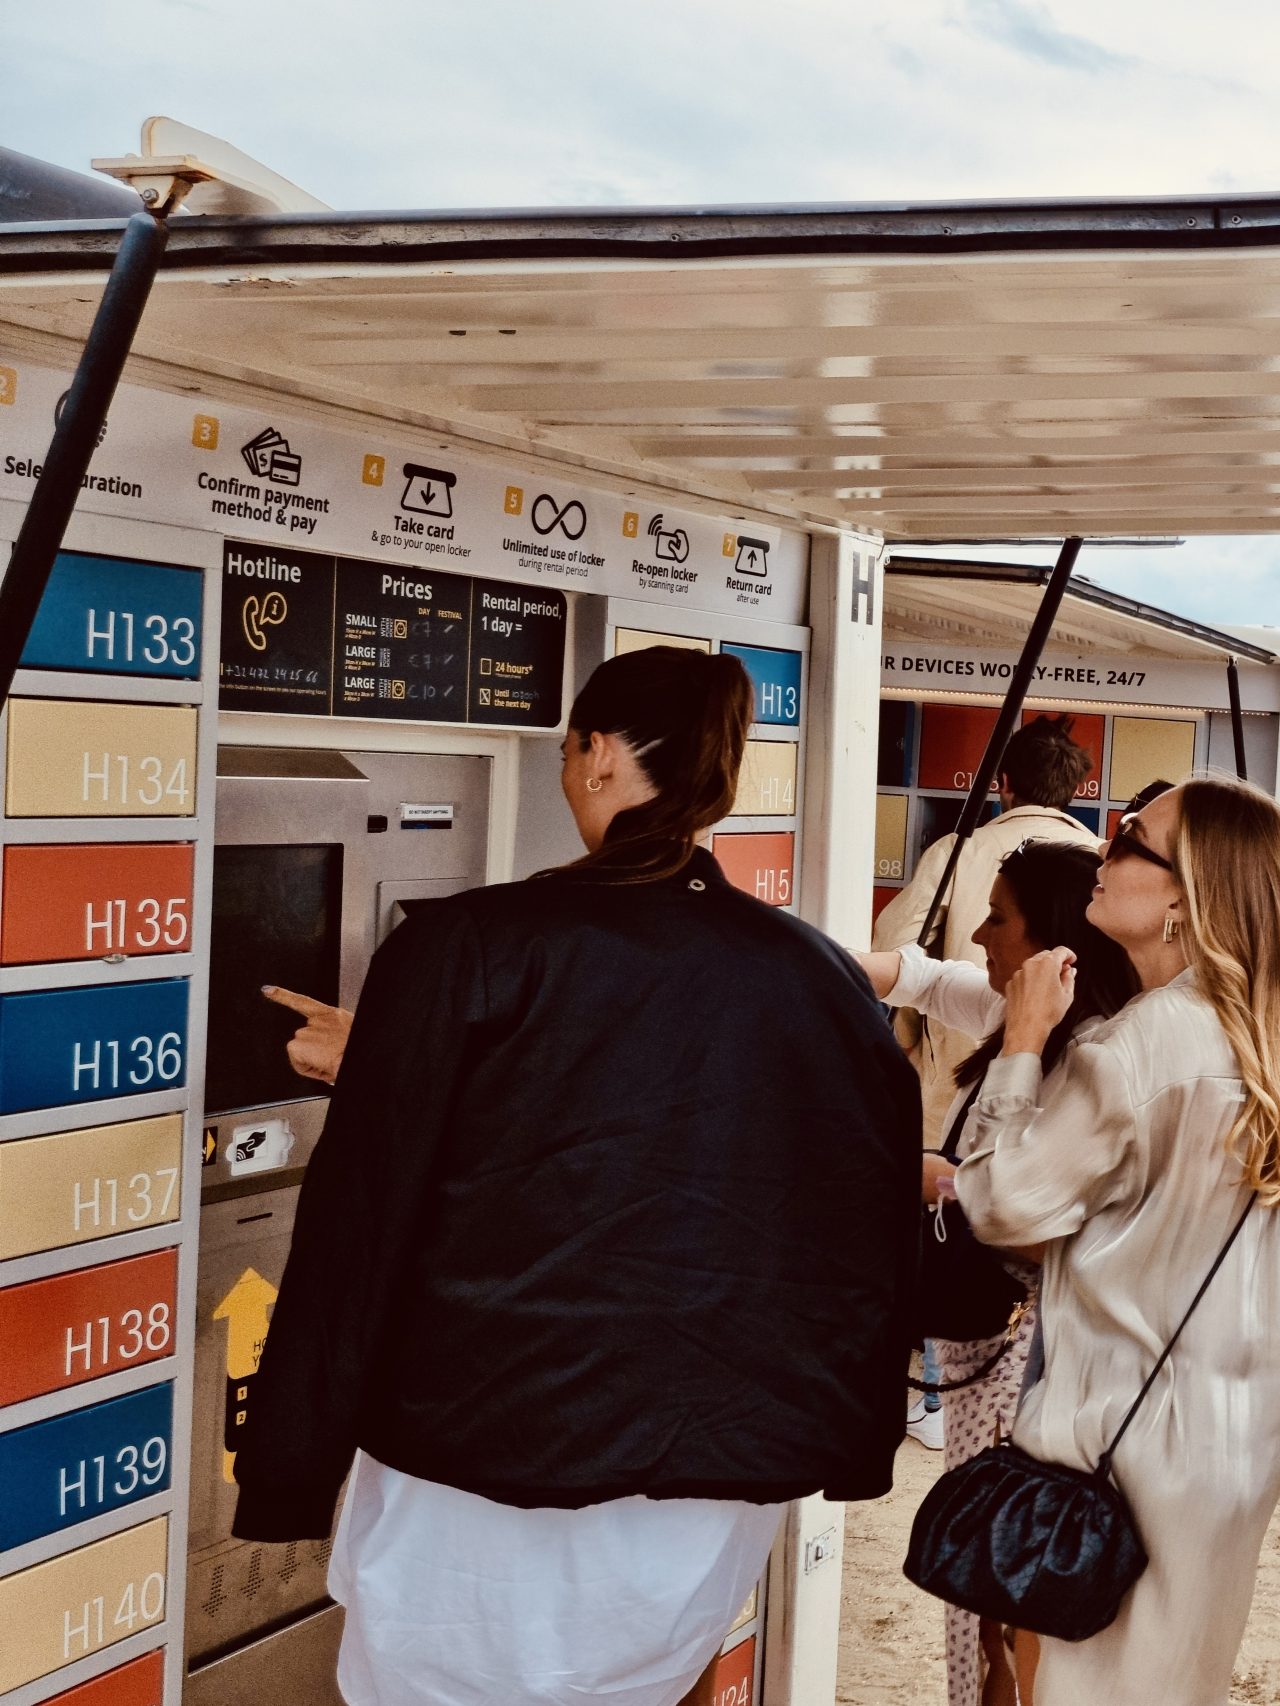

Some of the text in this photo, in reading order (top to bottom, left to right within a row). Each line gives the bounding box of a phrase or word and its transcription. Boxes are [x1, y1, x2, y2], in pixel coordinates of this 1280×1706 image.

[201, 423, 211, 440] 3
[4, 456, 142, 498] Sele uration
[368, 464, 377, 477] 4
[198, 472, 330, 513] Confirm payment
[510, 494, 517, 508] 5
[212, 500, 317, 534] method & pay
[394, 515, 454, 540] Take card
[627, 519, 634, 531] 6
[372, 531, 471, 557] & go to your open locker
[503, 538, 605, 567] Unlimited use of locker
[227, 553, 302, 585] Hotline
[518, 557, 588, 577] during rental period
[632, 560, 698, 582] Re-open locker
[381, 574, 433, 601] Prices
[639, 577, 688, 593] by scanning card
[726, 577, 772, 595] Return card
[736, 593, 749, 603] after
[851, 551, 876, 625] H
[418, 608, 462, 619] DAY FESTIVAL
[482, 592, 562, 620] Rental period,
[346, 614, 377, 628] SMALL
[482, 616, 488, 630] 1
[491, 617, 513, 637] day
[87, 608, 195, 666] H133
[345, 645, 376, 658] LARGE
[495, 662, 505, 672] 24
[881, 656, 1147, 688] R DEVICES WOY-FREE, 24/7
[344, 676, 375, 689] LARGE
[495, 689, 509, 698] Until
[495, 698, 531, 710] the next day
[761, 682, 797, 719] H13
[83, 751, 189, 805] H134
[760, 776, 792, 810] H14
[755, 868, 789, 902] H15
[85, 898, 187, 951] H135
[73, 1032, 182, 1091] H136
[73, 1168, 178, 1231] H137
[65, 1302, 170, 1376] H138
[59, 1437, 167, 1516] H139
[62, 1571, 165, 1659] H140
